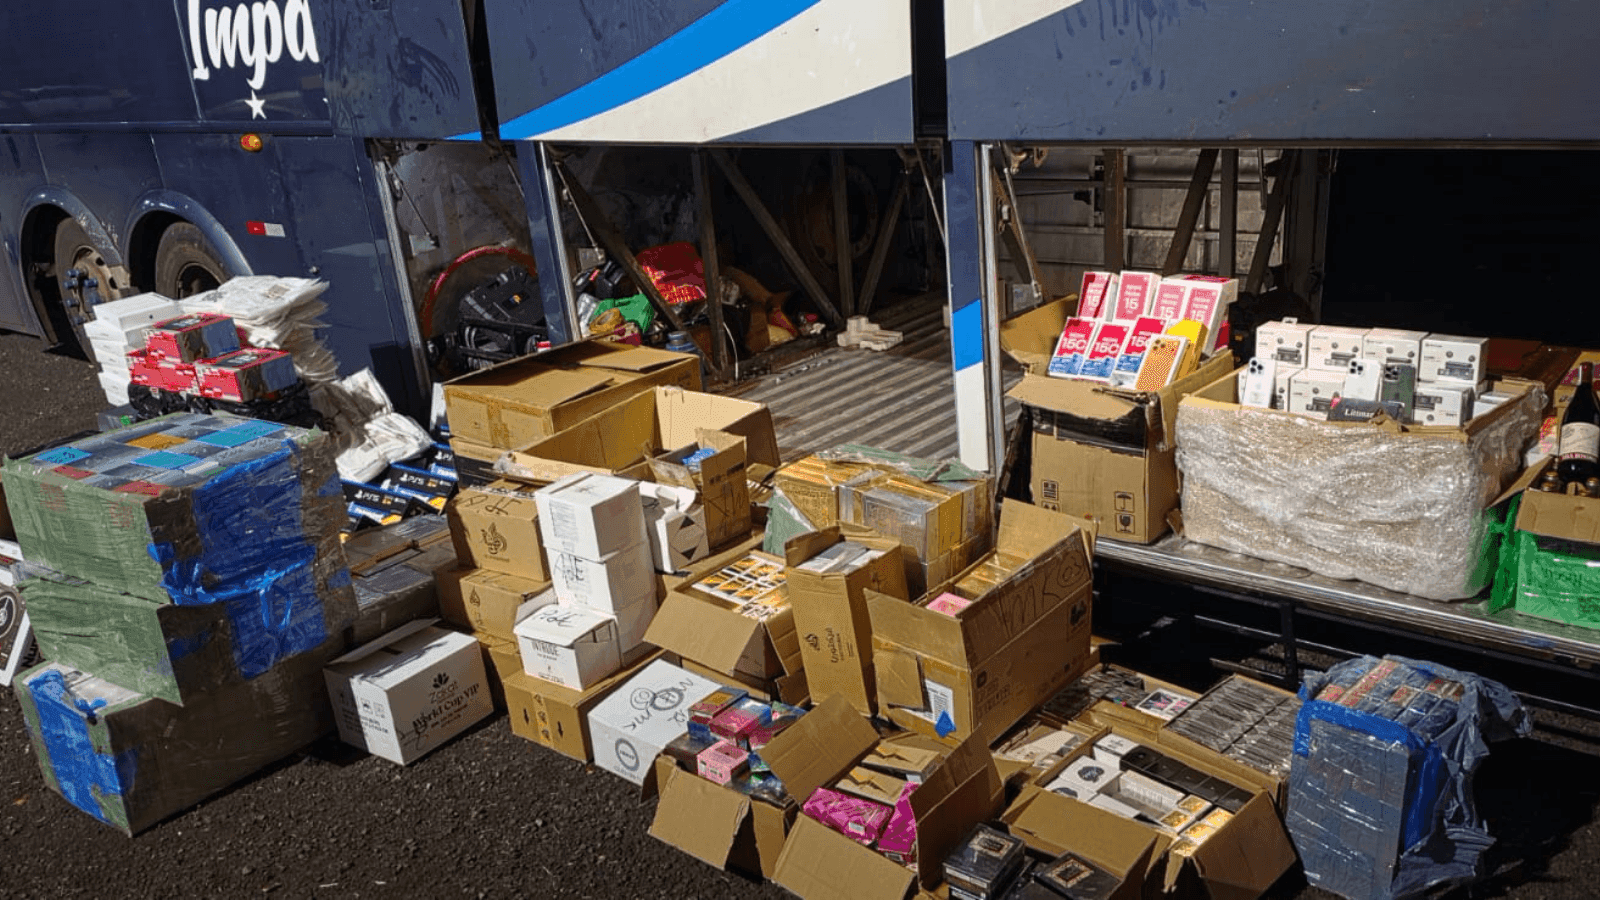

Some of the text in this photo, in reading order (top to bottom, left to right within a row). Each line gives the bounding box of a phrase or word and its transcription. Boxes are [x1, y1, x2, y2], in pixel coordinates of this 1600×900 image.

[1123, 297, 1140, 310] 15
[1063, 338, 1088, 351] 15C
[1095, 341, 1121, 355] 15C
